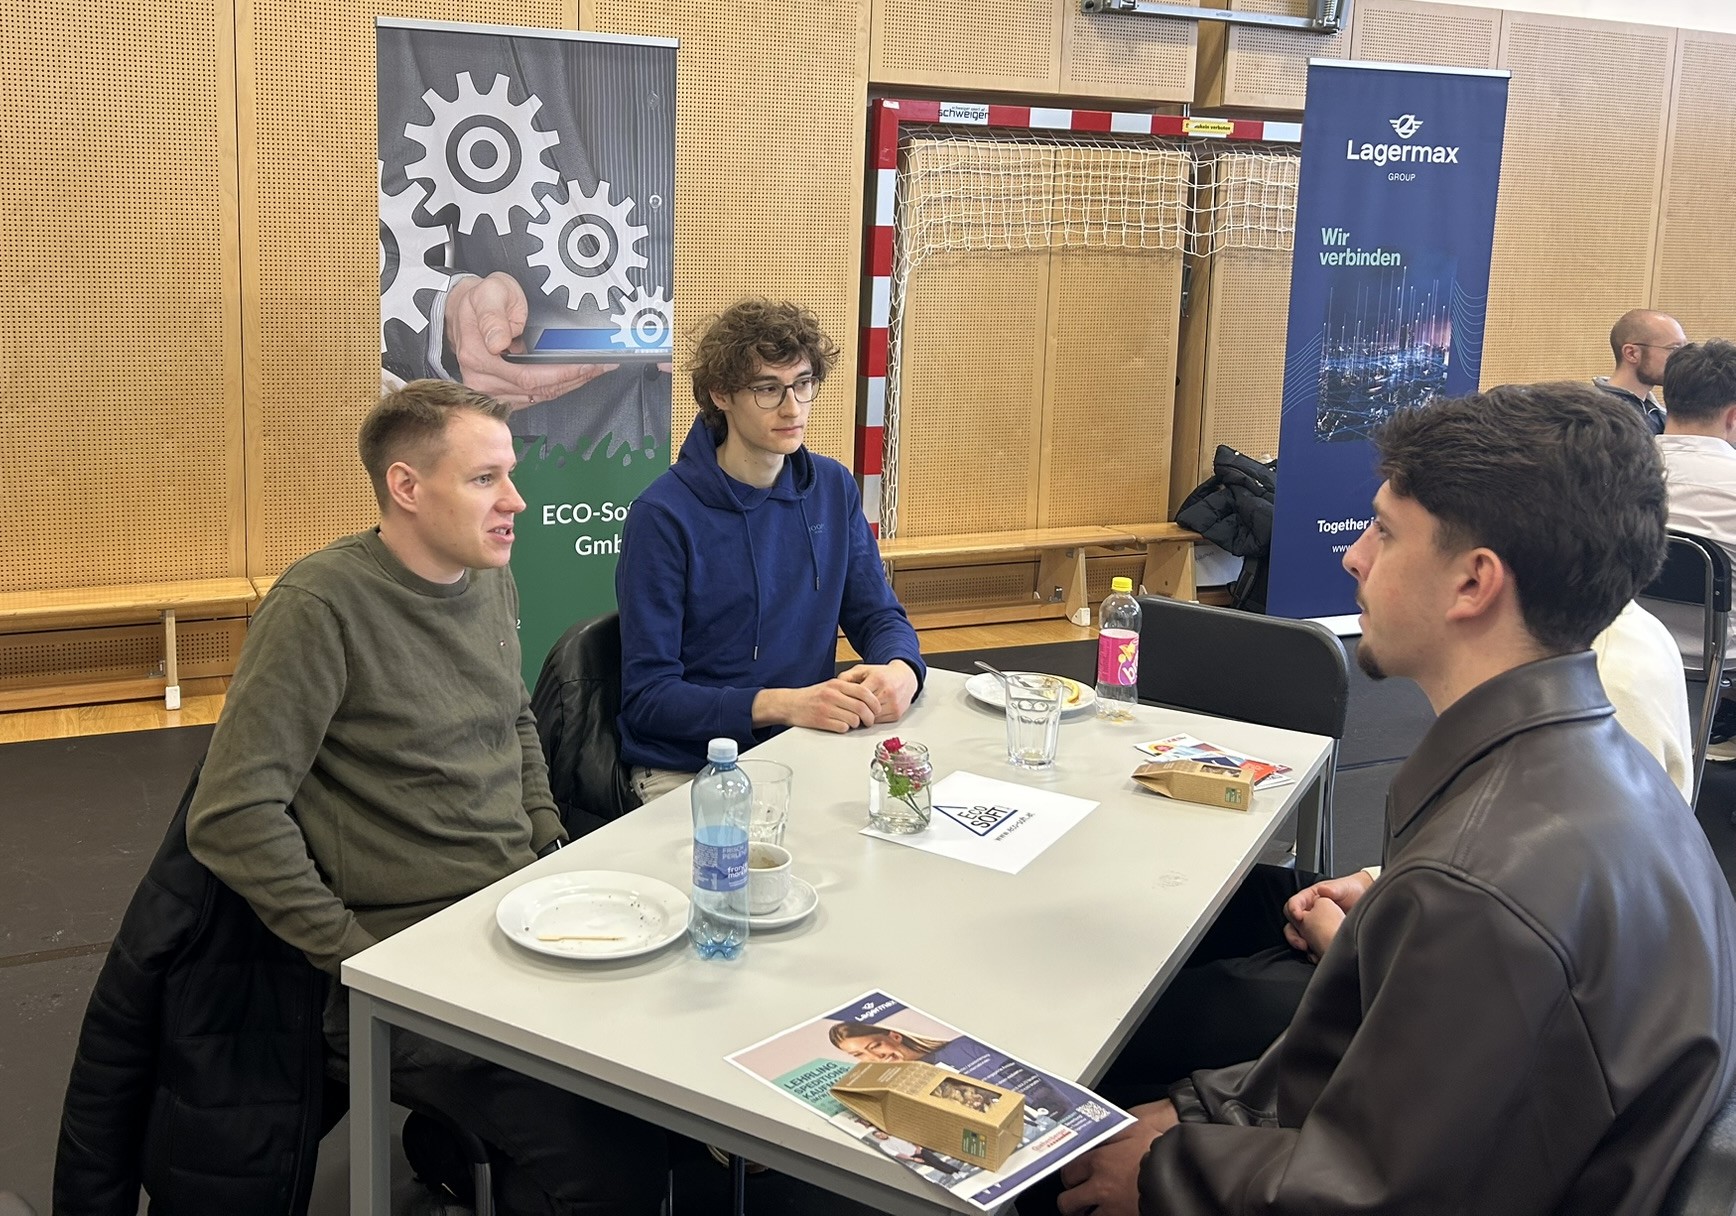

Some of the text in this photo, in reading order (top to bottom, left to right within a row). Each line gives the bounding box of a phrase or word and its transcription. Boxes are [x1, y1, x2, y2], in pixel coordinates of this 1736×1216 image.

[938, 109, 990, 121] schweiger
[1347, 140, 1459, 166] Lagermax
[1388, 172, 1416, 181] GROUP
[1321, 227, 1350, 246] Wir
[1320, 248, 1401, 266] verbinden
[1317, 518, 1370, 534] Together
[970, 806, 1008, 829] SOFT
[854, 1000, 897, 1022] Lagermax
[784, 1061, 838, 1090] LEHRLING
[793, 1066, 851, 1095] SPEDITIONS-
